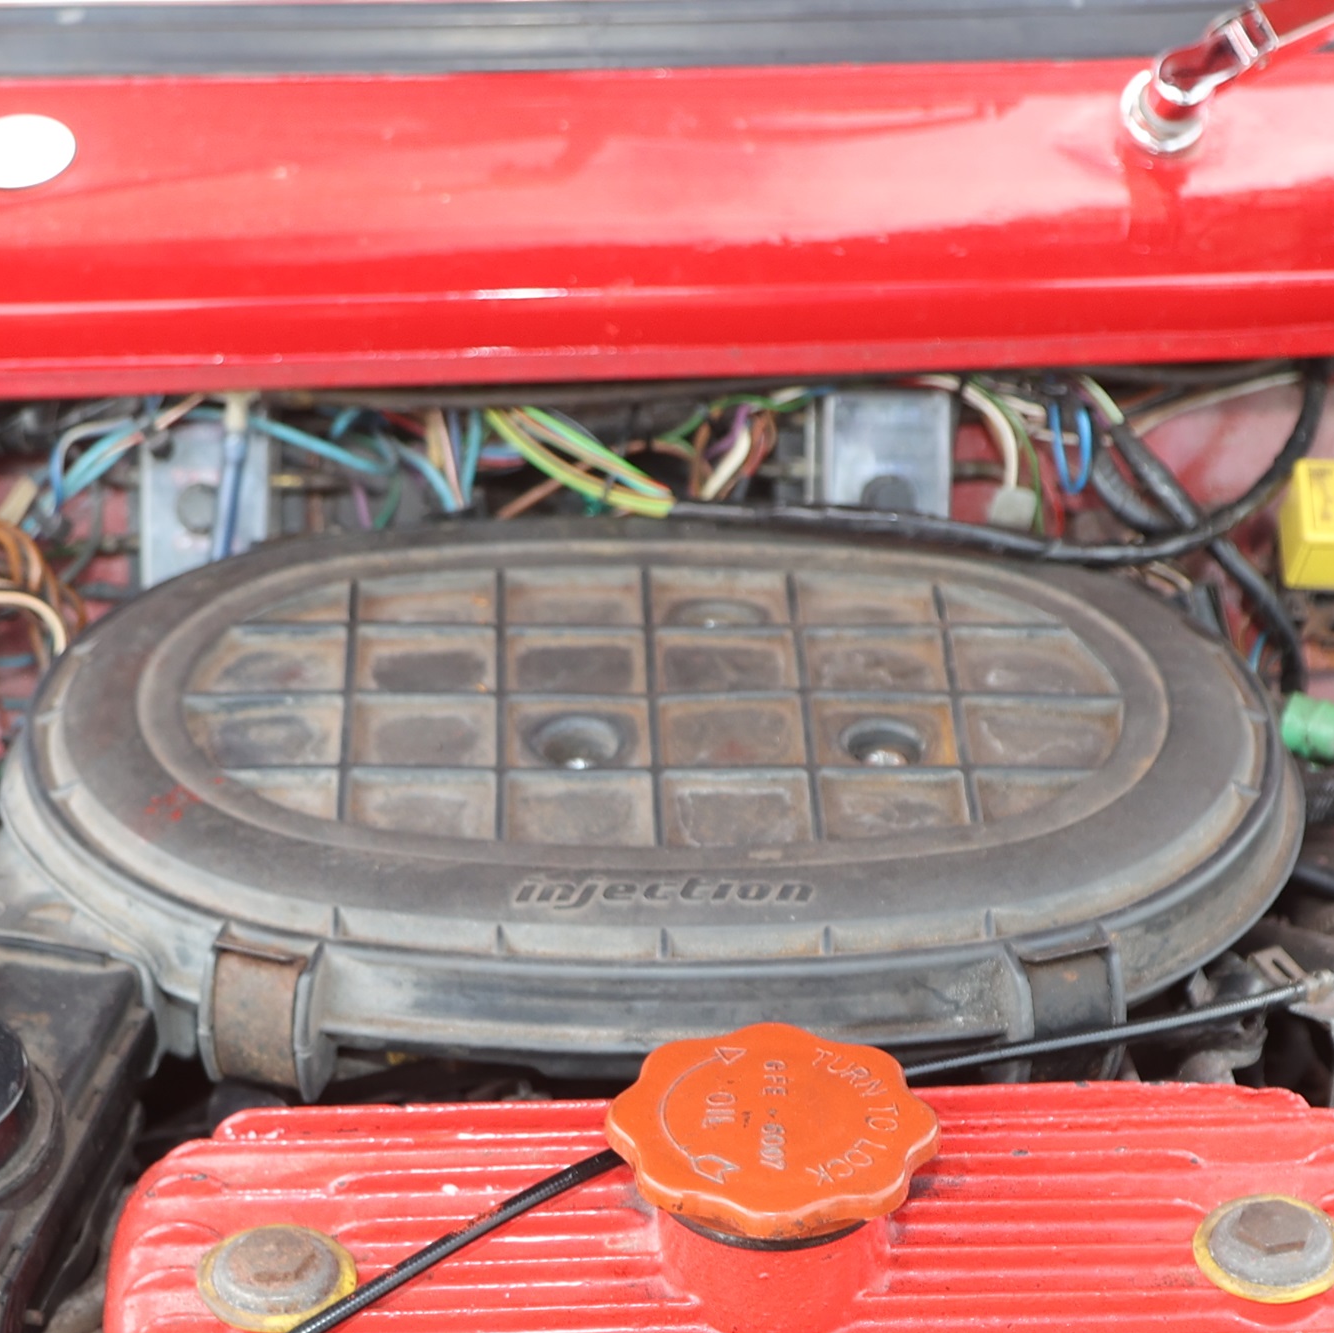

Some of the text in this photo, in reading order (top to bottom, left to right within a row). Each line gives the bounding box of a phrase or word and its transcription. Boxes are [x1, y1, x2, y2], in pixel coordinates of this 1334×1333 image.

[516, 877, 814, 910] injection
[762, 1059, 788, 1096] GFE
[702, 1091, 736, 1128] OIL
[805, 1048, 898, 1187] TURN TO LOCK
